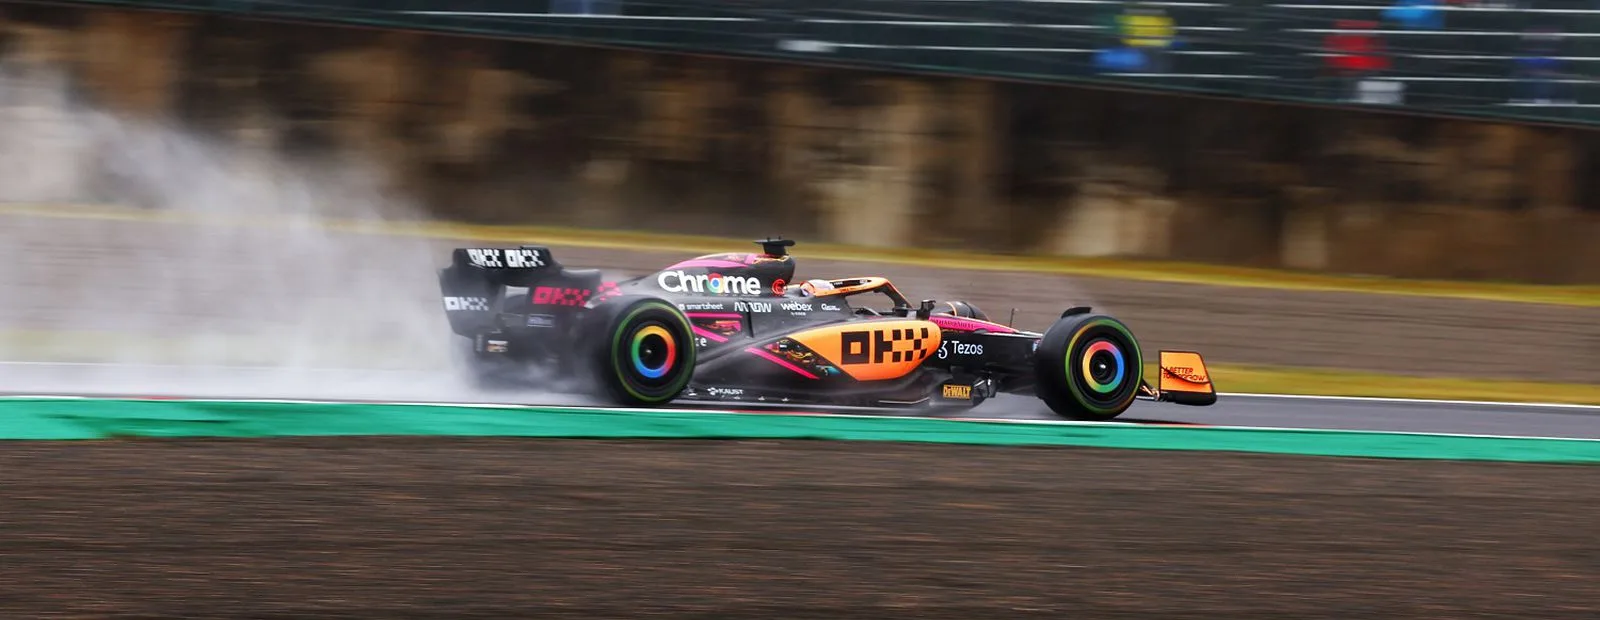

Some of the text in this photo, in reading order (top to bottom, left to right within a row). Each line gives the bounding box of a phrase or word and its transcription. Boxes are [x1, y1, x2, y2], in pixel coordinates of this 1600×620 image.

[466, 248, 546, 268] OKX OKX
[657, 270, 761, 297] Chrome
[443, 296, 490, 311] OKX
[780, 301, 813, 311] webex
[841, 328, 928, 365] OKX
[951, 340, 984, 355] Tezos
